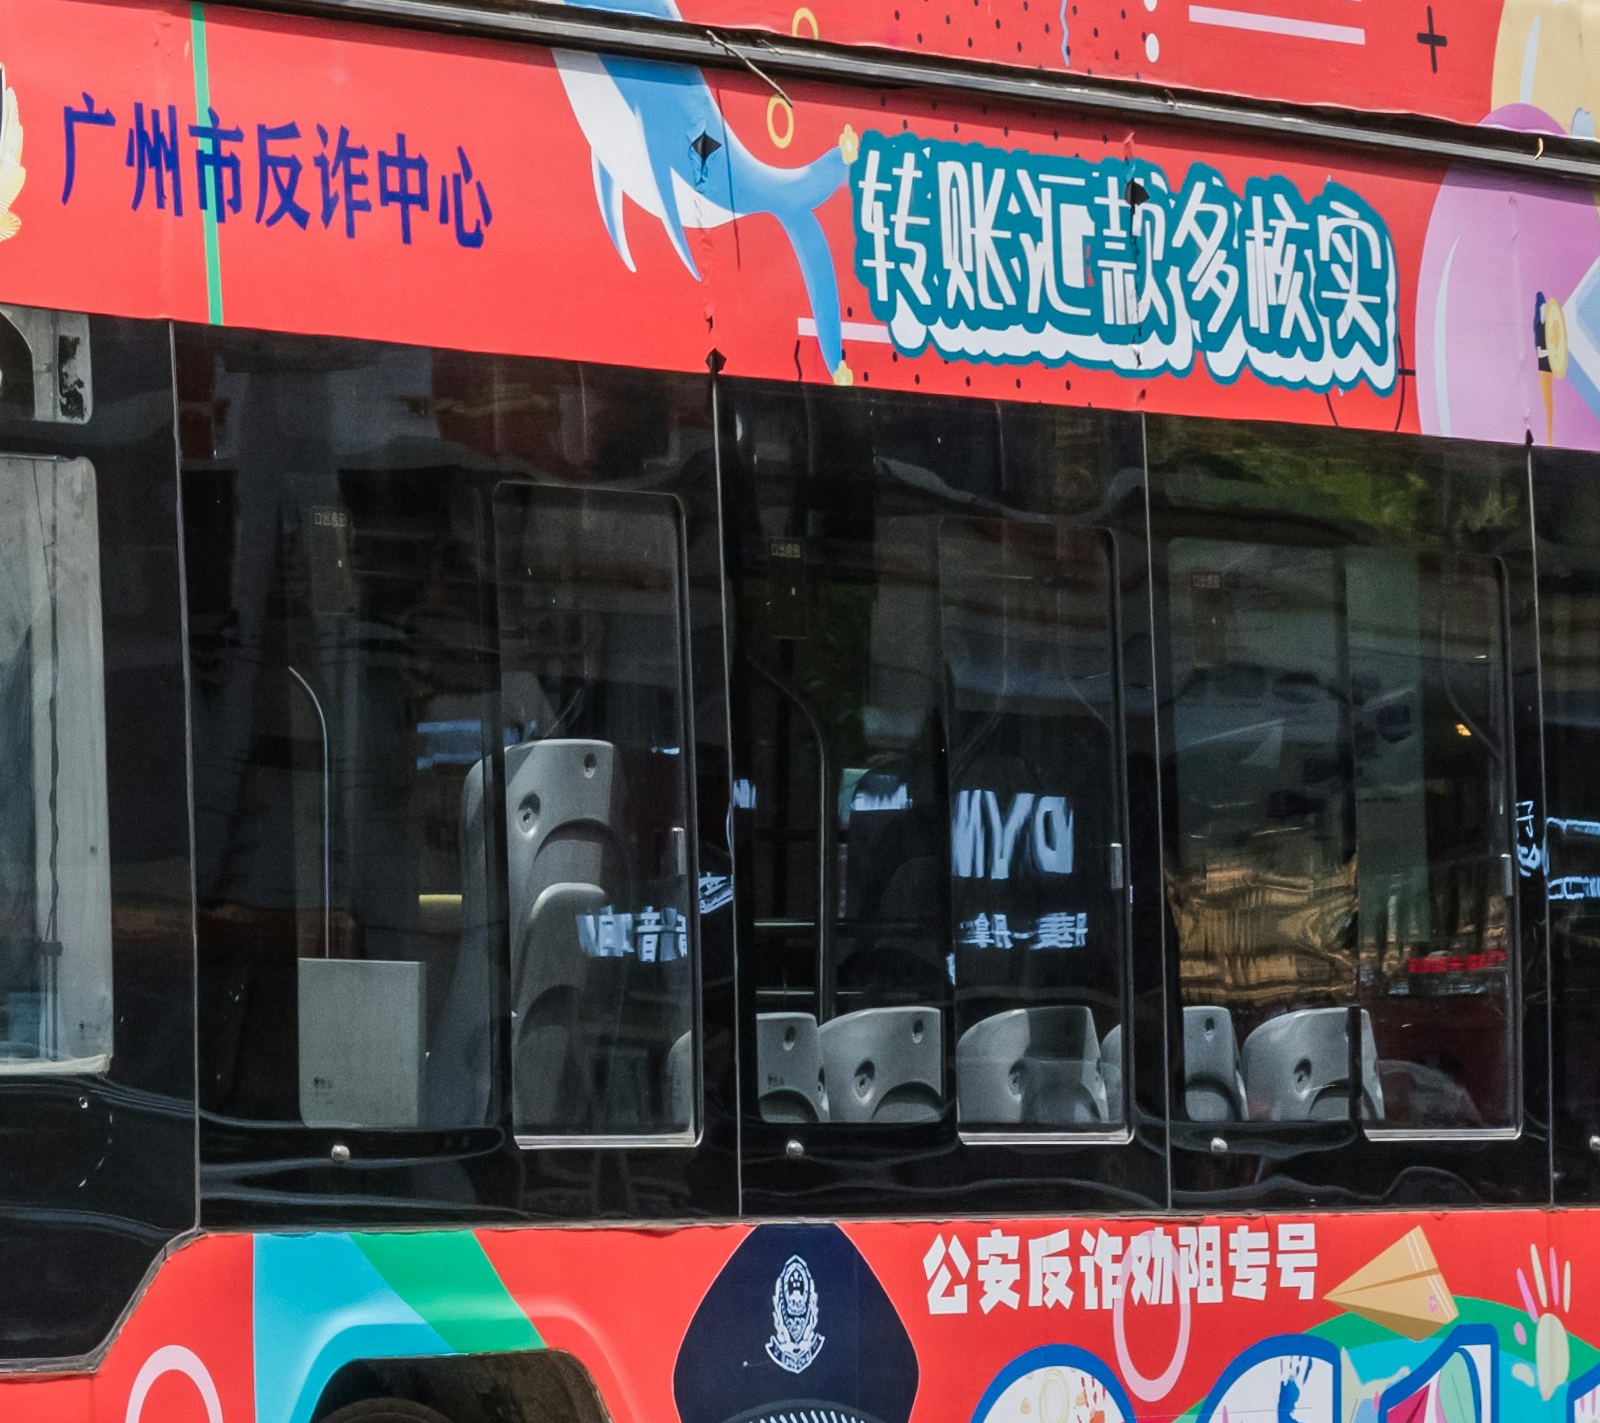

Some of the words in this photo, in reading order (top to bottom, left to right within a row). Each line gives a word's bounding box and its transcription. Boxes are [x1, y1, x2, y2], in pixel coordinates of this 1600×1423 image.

[61, 92, 493, 250] 广州市反诈中心
[858, 148, 1390, 350] 转账汇款多核实
[922, 1223, 1319, 1317] 公安反诈劝阻专号
